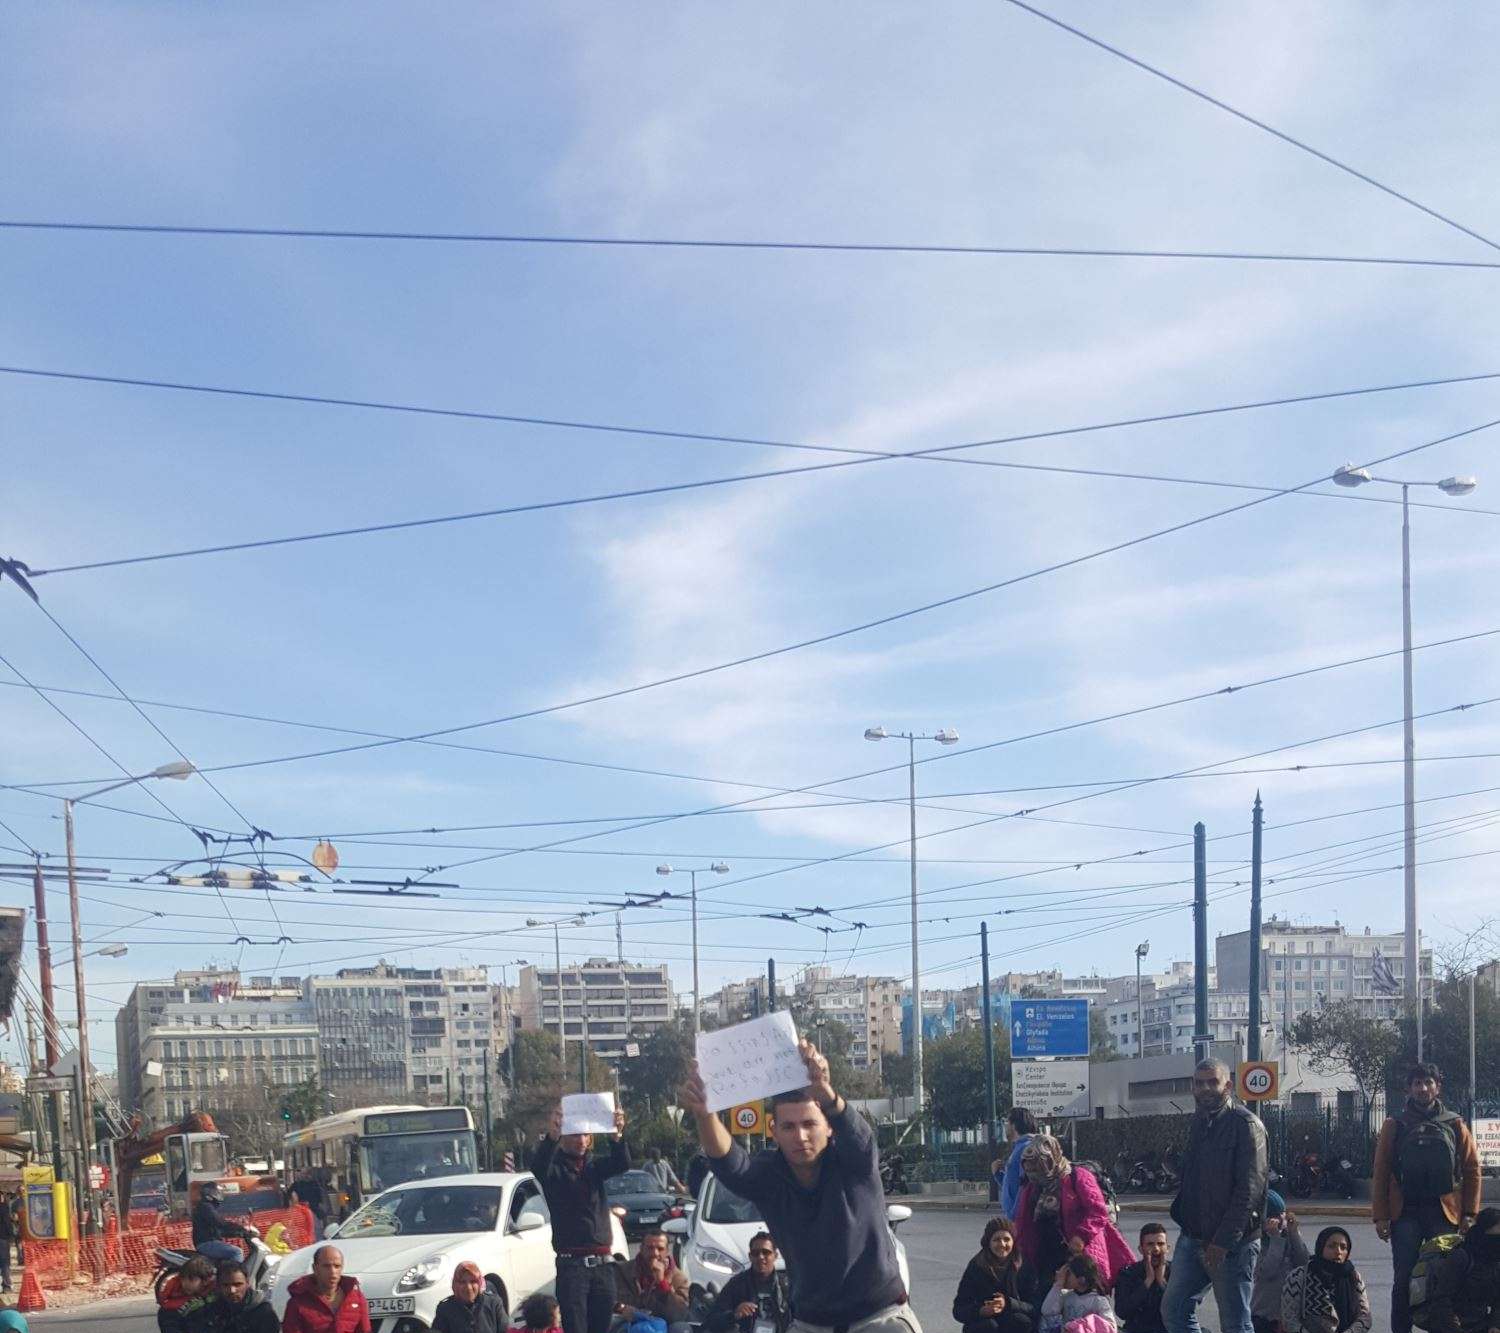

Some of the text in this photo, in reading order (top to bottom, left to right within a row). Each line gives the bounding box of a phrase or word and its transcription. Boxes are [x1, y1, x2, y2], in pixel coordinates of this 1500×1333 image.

[1025, 1073, 1046, 1081] Center
[1250, 1075, 1268, 1087] 40
[740, 1113, 754, 1124] 40
